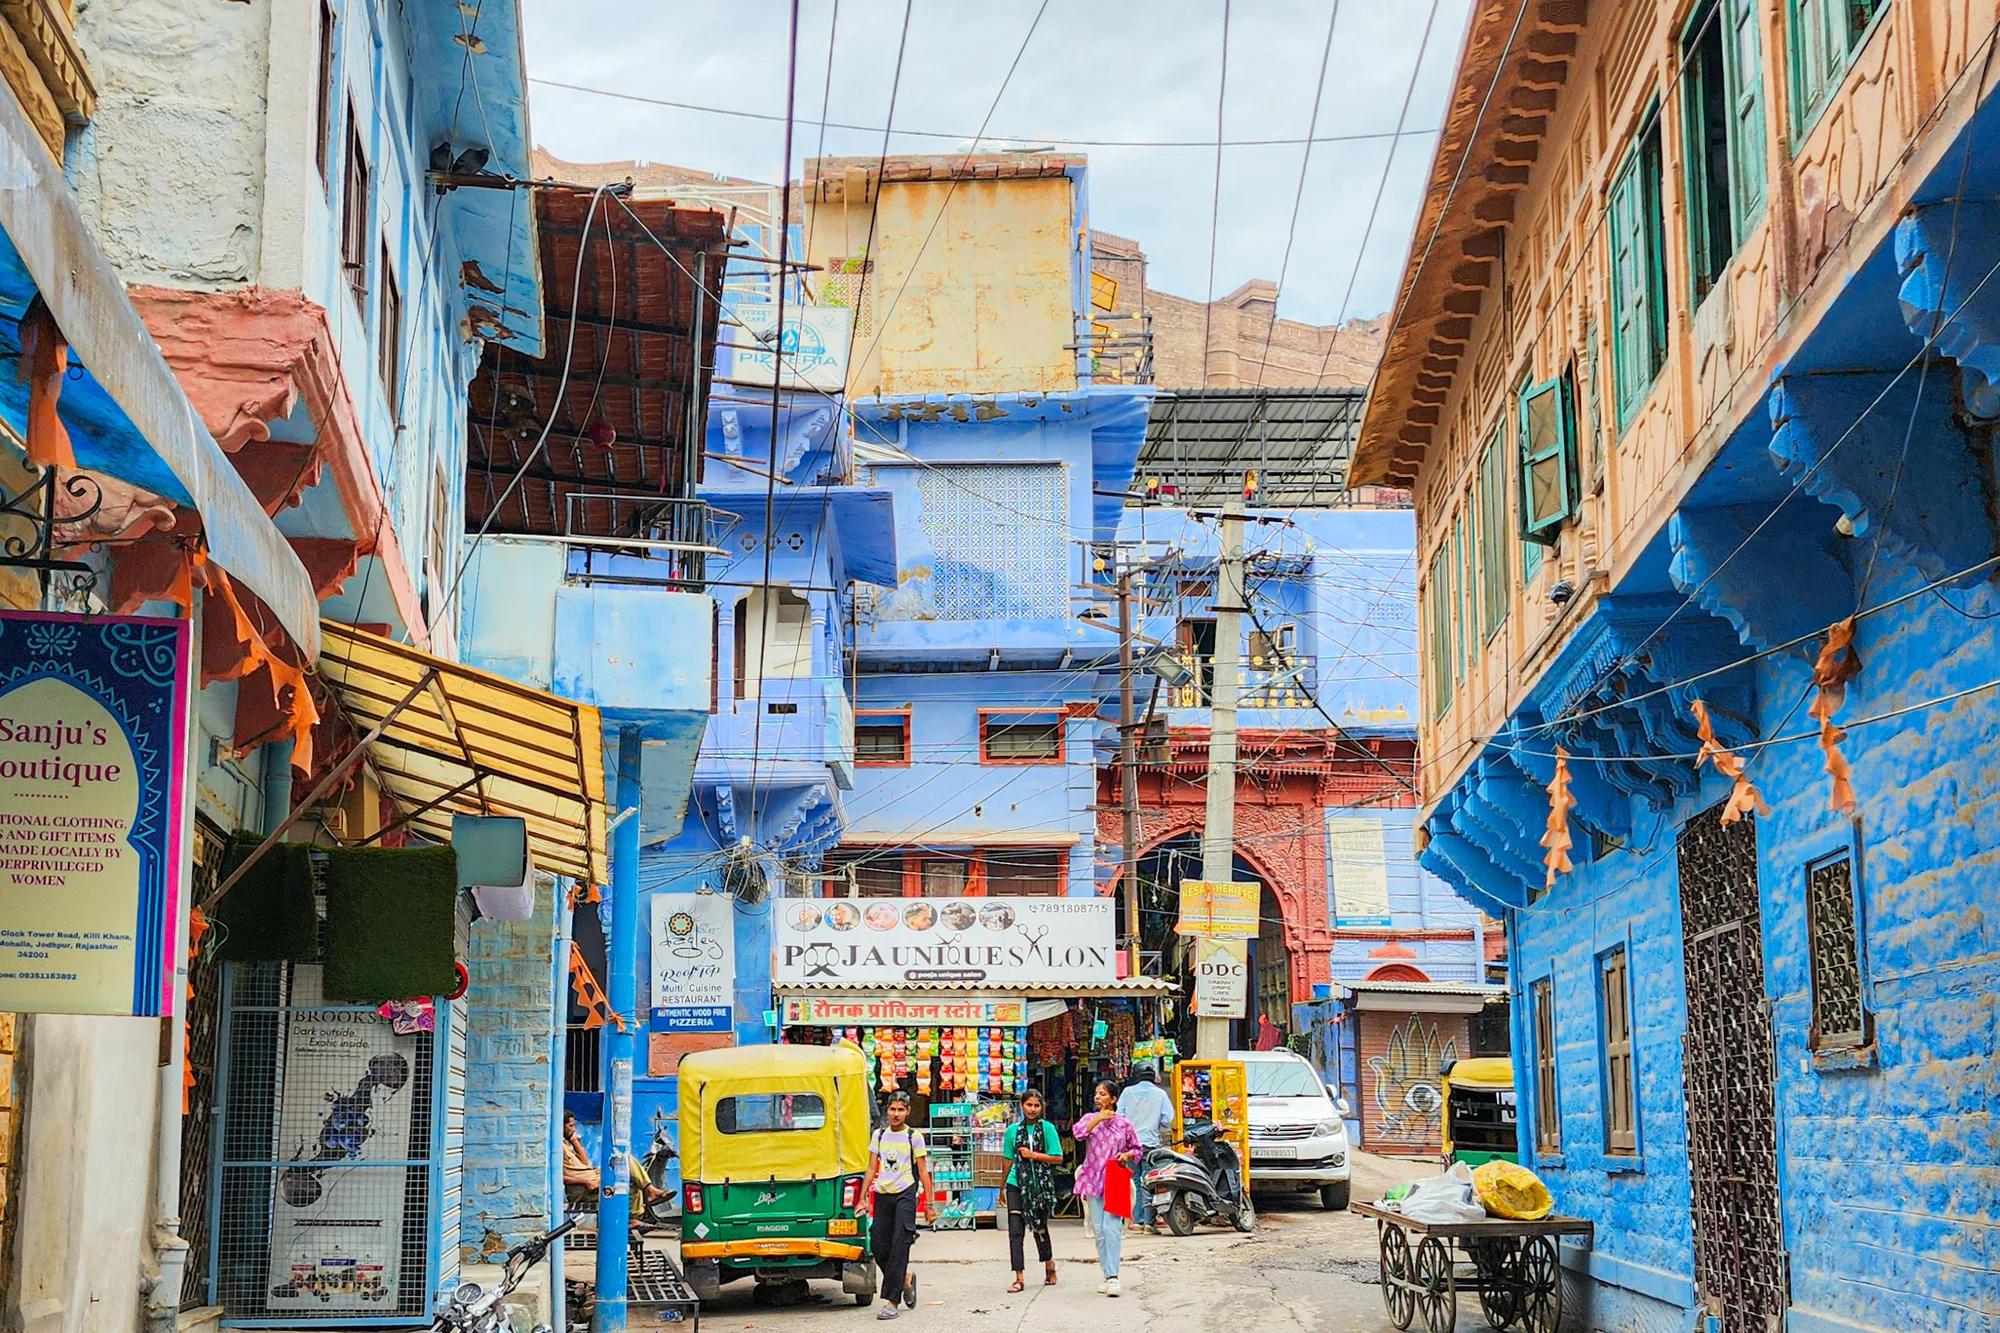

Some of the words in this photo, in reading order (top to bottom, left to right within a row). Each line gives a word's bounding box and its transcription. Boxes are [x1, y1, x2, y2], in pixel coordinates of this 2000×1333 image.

[739, 352, 838, 367] PIZERIA
[0, 756, 121, 787] outique
[0, 814, 51, 826] TIONAL
[6, 829, 36, 840] AND
[39, 831, 71, 842] GIFT
[74, 832, 116, 844] ITEMS
[0, 844, 38, 855] MADE
[41, 845, 102, 857] LOCALLY
[105, 848, 122, 858] BY
[11, 873, 66, 886] WOMEN
[76, 942, 118, 951] Rajasthan
[1201, 963, 1243, 976] DDC
[662, 984, 683, 992] Multi
[689, 984, 721, 992] Cuisine
[662, 995, 721, 1004] RESTAURANT
[657, 1008, 692, 1018] AUTHENTIC
[693, 1008, 712, 1017] WOOD
[713, 1008, 727, 1017] FIRE
[943, 1000, 983, 1018] स्टोर
[669, 1018, 714, 1027] PIZZERIA
